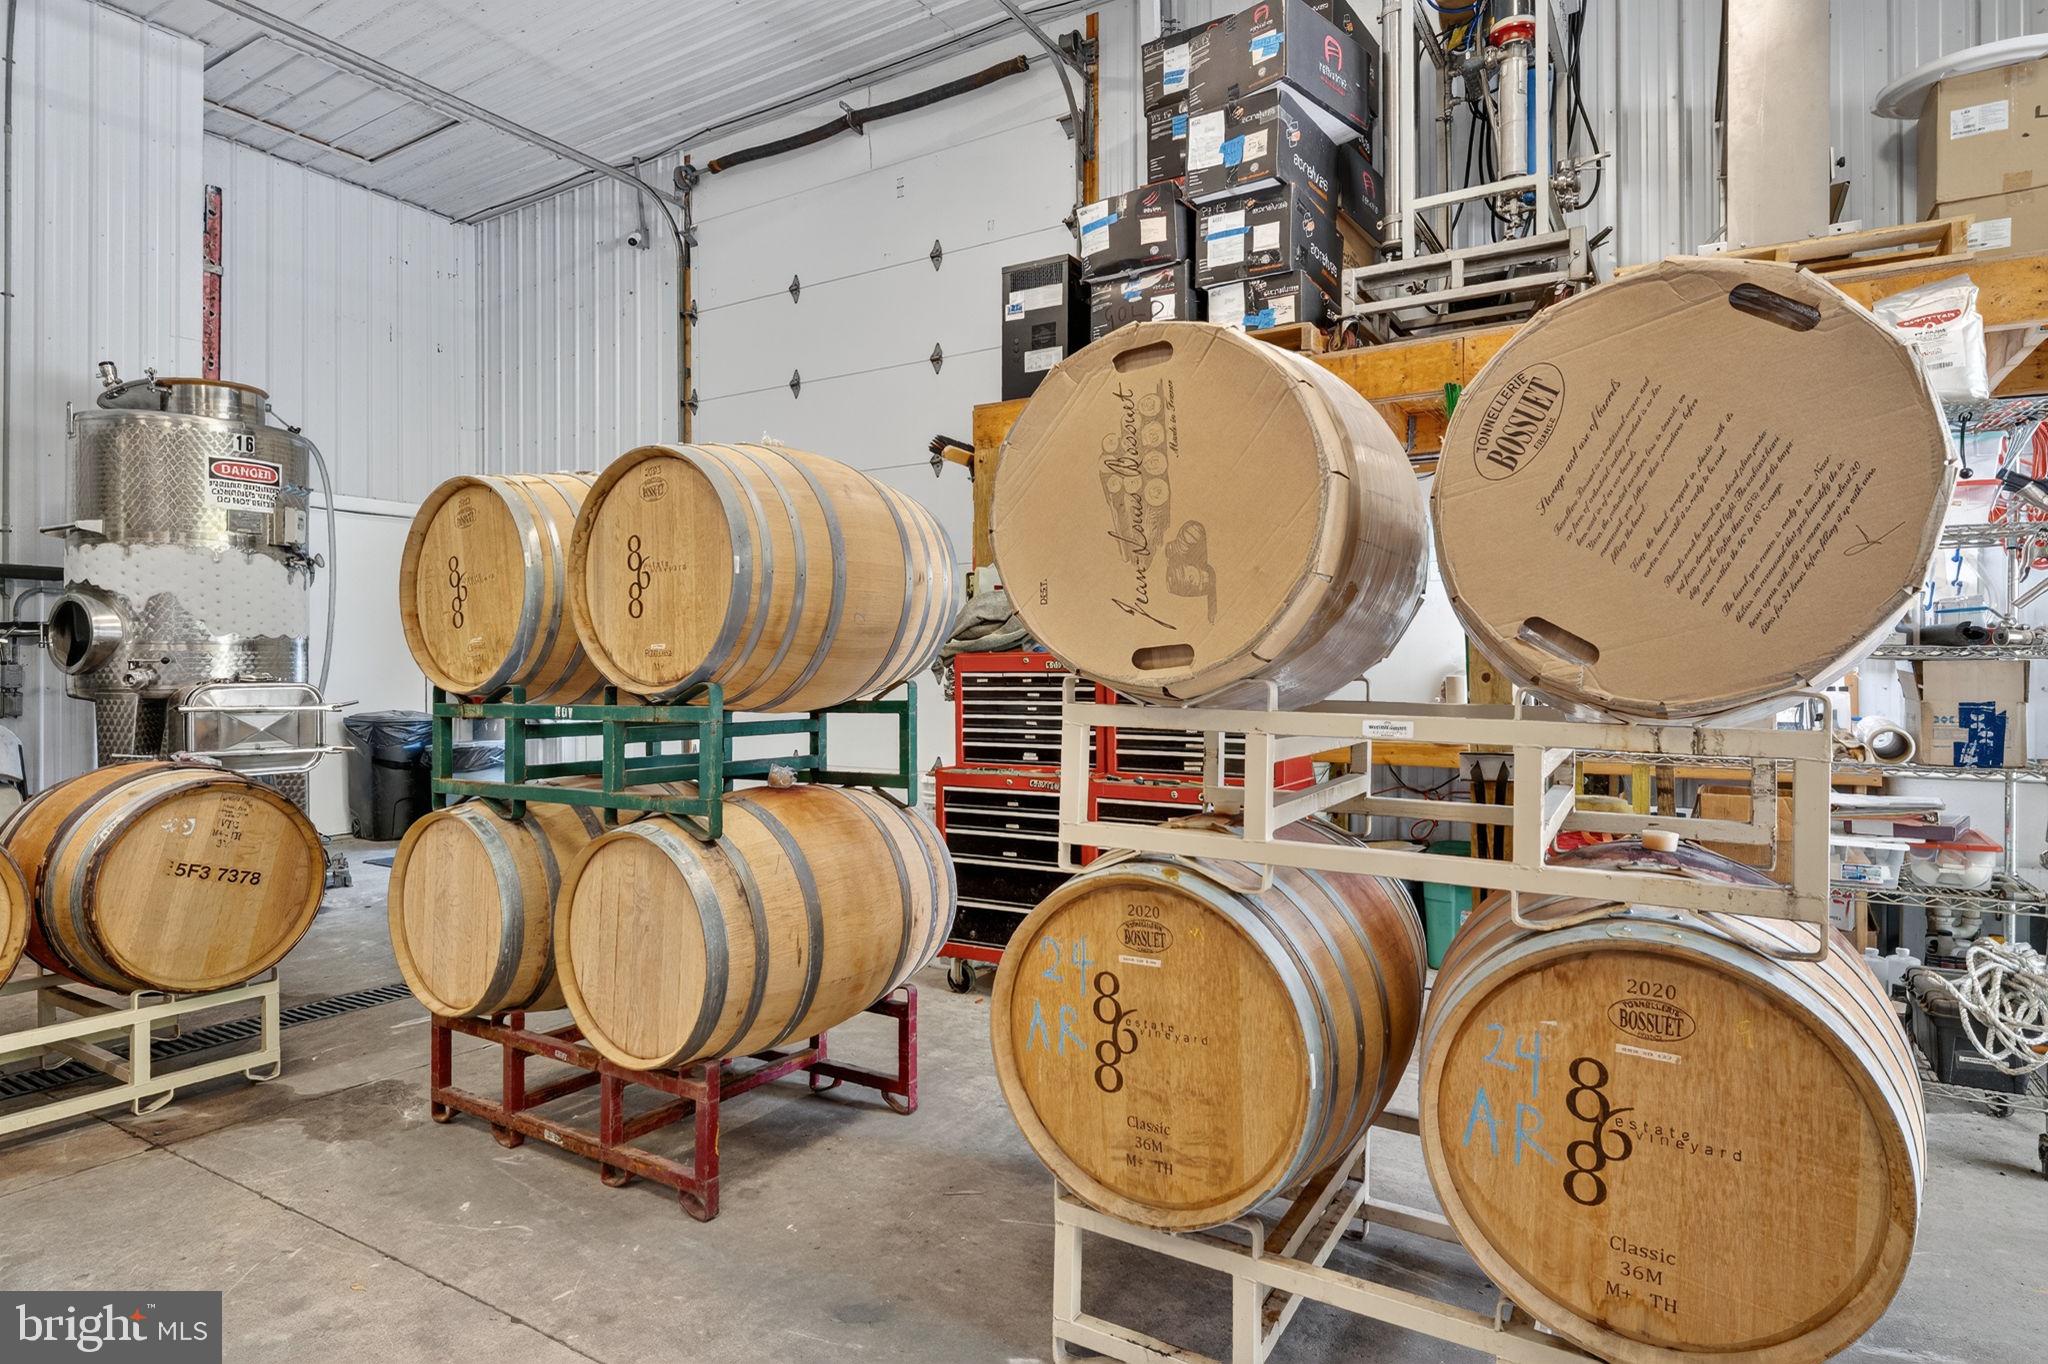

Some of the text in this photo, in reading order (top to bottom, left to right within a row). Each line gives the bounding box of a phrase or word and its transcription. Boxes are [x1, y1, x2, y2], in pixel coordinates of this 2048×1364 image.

[1476, 372, 1529, 453] TONNELLERIE
[1486, 376, 1560, 472] BOSSUET
[236, 435, 254, 452] 16
[1565, 447, 1579, 473] and
[1589, 417, 1600, 433] of
[221, 464, 272, 480] DANGER
[218, 868, 261, 885] 7378
[1127, 904, 1160, 919] 2020
[1124, 928, 1166, 948] BOSSUET
[1040, 935, 1095, 998] 24
[1627, 979, 1676, 1000] 2020
[1025, 999, 1088, 1056] AR
[1125, 1018, 1175, 1032] estate
[1620, 1008, 1684, 1037] BOSSUET
[1140, 1028, 1208, 1046] vineyard
[1482, 1023, 1547, 1099] 24
[1126, 1116, 1171, 1136] Classic
[1462, 1088, 1559, 1167] AR
[1616, 1117, 1691, 1141] estate
[1135, 1136, 1163, 1153] 36M
[1636, 1132, 1742, 1162] vineyard
[1610, 1235, 1676, 1266] Classic
[1620, 1261, 1663, 1286] 36M
[1606, 1280, 1678, 1314] M+ TH
